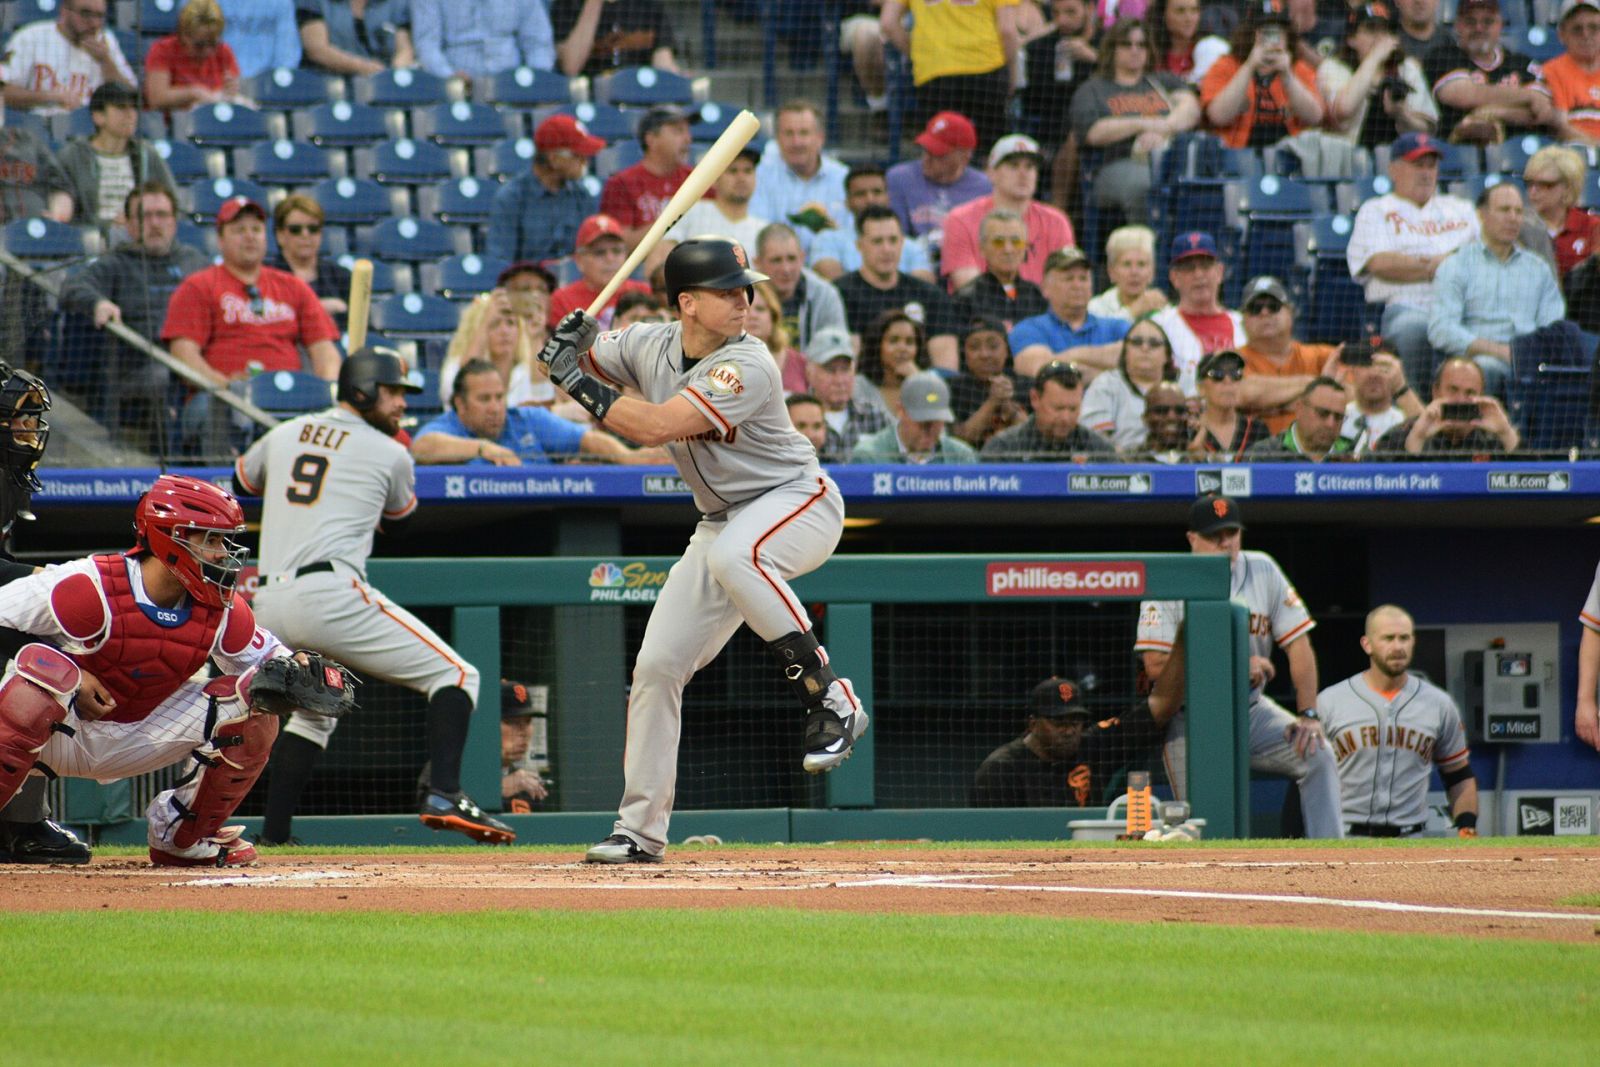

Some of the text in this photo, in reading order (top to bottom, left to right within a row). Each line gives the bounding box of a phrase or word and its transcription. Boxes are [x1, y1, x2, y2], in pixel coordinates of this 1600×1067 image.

[299, 423, 350, 451] BELT
[285, 452, 330, 507] 9
[469, 478, 595, 494] Citizens Bank Park
[896, 475, 1019, 491] Citizens Bank Park
[1071, 475, 1127, 491] MLB.com
[1318, 474, 1439, 490] Citizens Bank Park
[1491, 475, 1546, 489] MLB.com
[94, 480, 130, 496] Bank
[992, 567, 1139, 594] phillies.com
[1506, 720, 1537, 734] Mitel
[1559, 805, 1587, 817] NEW
[1559, 817, 1587, 829] ERA
